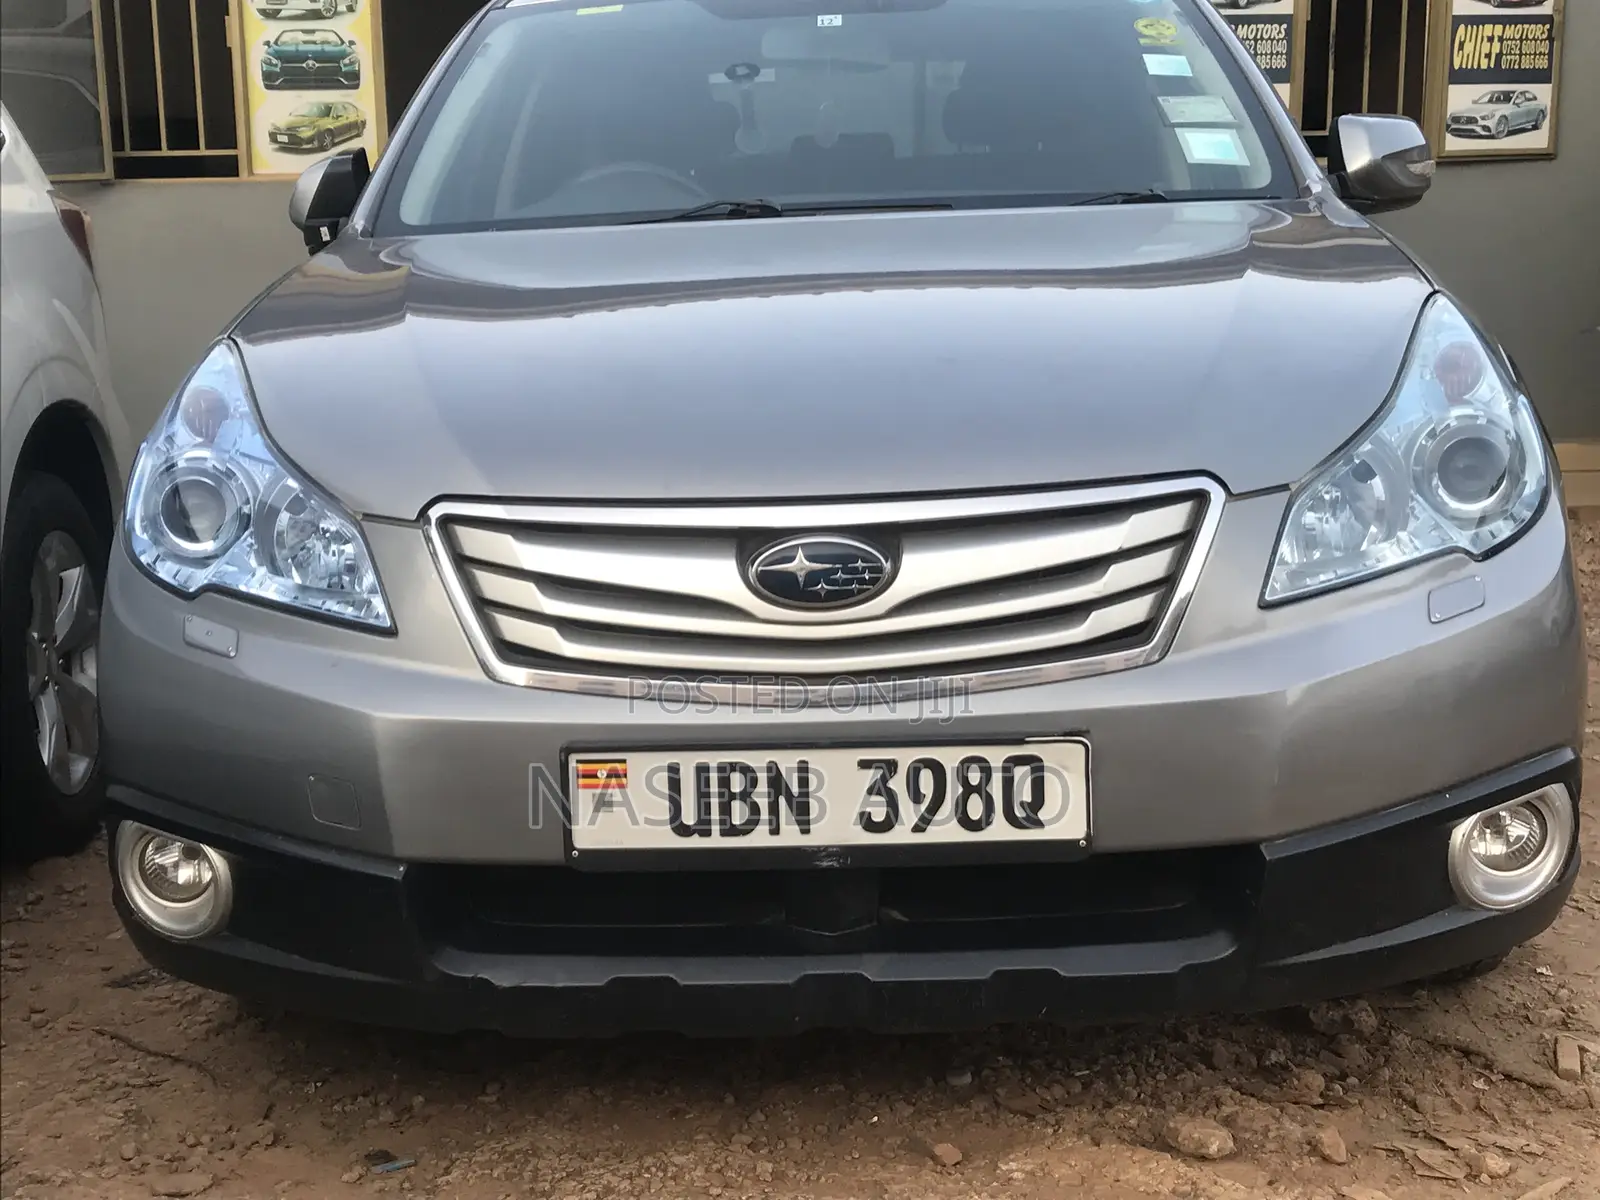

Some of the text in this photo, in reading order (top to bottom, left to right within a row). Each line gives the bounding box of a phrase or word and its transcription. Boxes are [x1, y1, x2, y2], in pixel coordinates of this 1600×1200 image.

[1236, 23, 1287, 39] MOTORS
[1502, 24, 1550, 39] MOTORS
[1256, 40, 1271, 54] 608
[1272, 40, 1288, 54] 040
[1453, 23, 1503, 70] CHIEF
[1502, 40, 1550, 54] 0752 608 040
[1271, 55, 1287, 69] 666
[1501, 55, 1549, 69] 0772 885 666
[667, 754, 1046, 838] UBN 398Q
